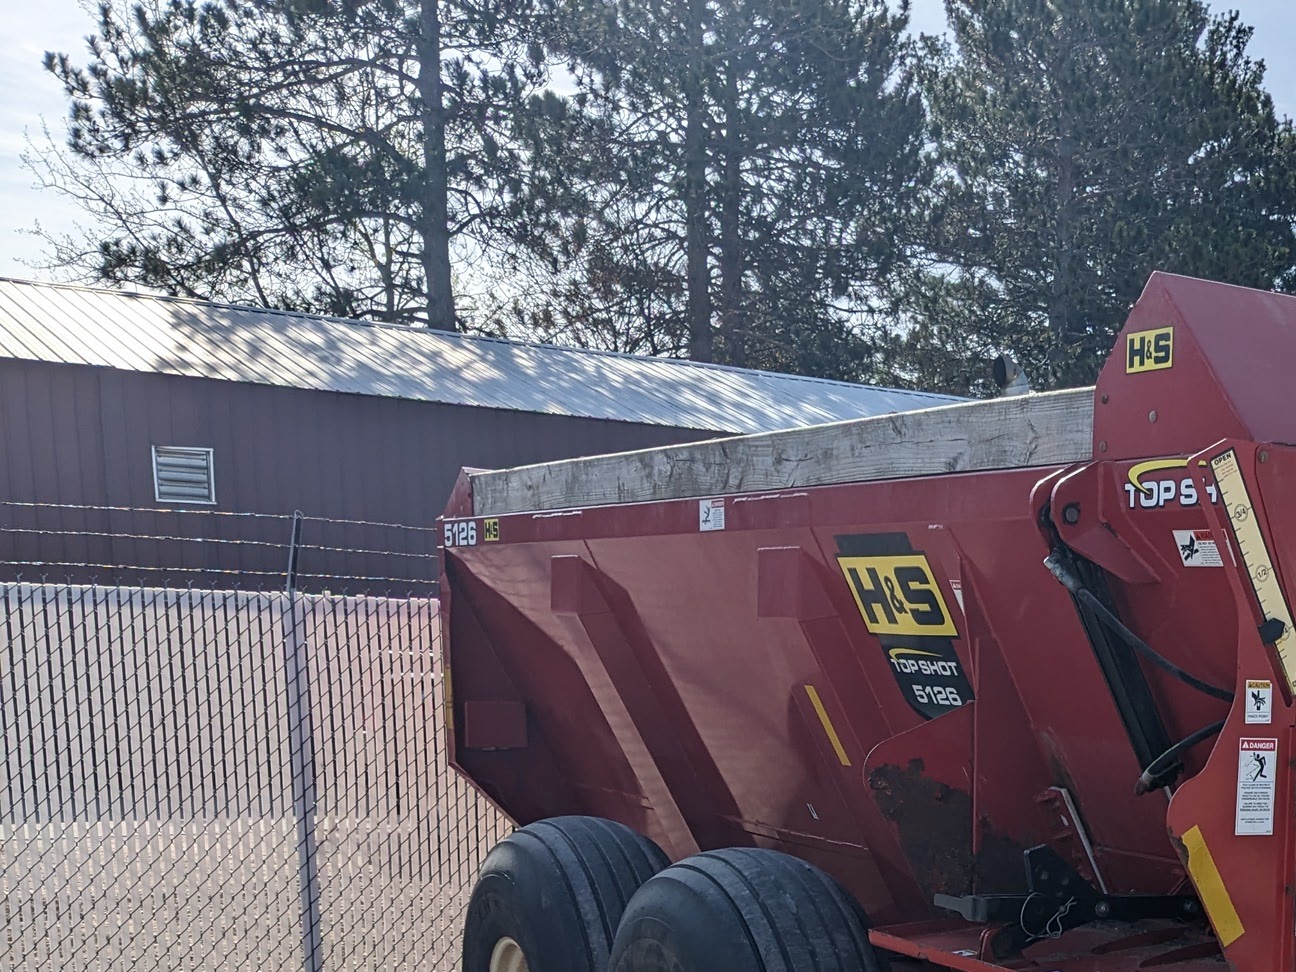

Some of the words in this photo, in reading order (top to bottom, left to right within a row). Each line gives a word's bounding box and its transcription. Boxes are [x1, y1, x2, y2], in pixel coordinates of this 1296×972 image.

[1128, 332, 1171, 369] H&S
[1213, 452, 1232, 466] OPEN
[1124, 479, 1176, 508] TOP
[444, 521, 477, 547] 5126
[1258, 568, 1268, 578] 1/2
[847, 565, 946, 626] H&S
[891, 658, 920, 674] TOP
[919, 660, 959, 677] SHOT
[912, 684, 962, 706] 5126
[1249, 741, 1274, 750] DANGER
